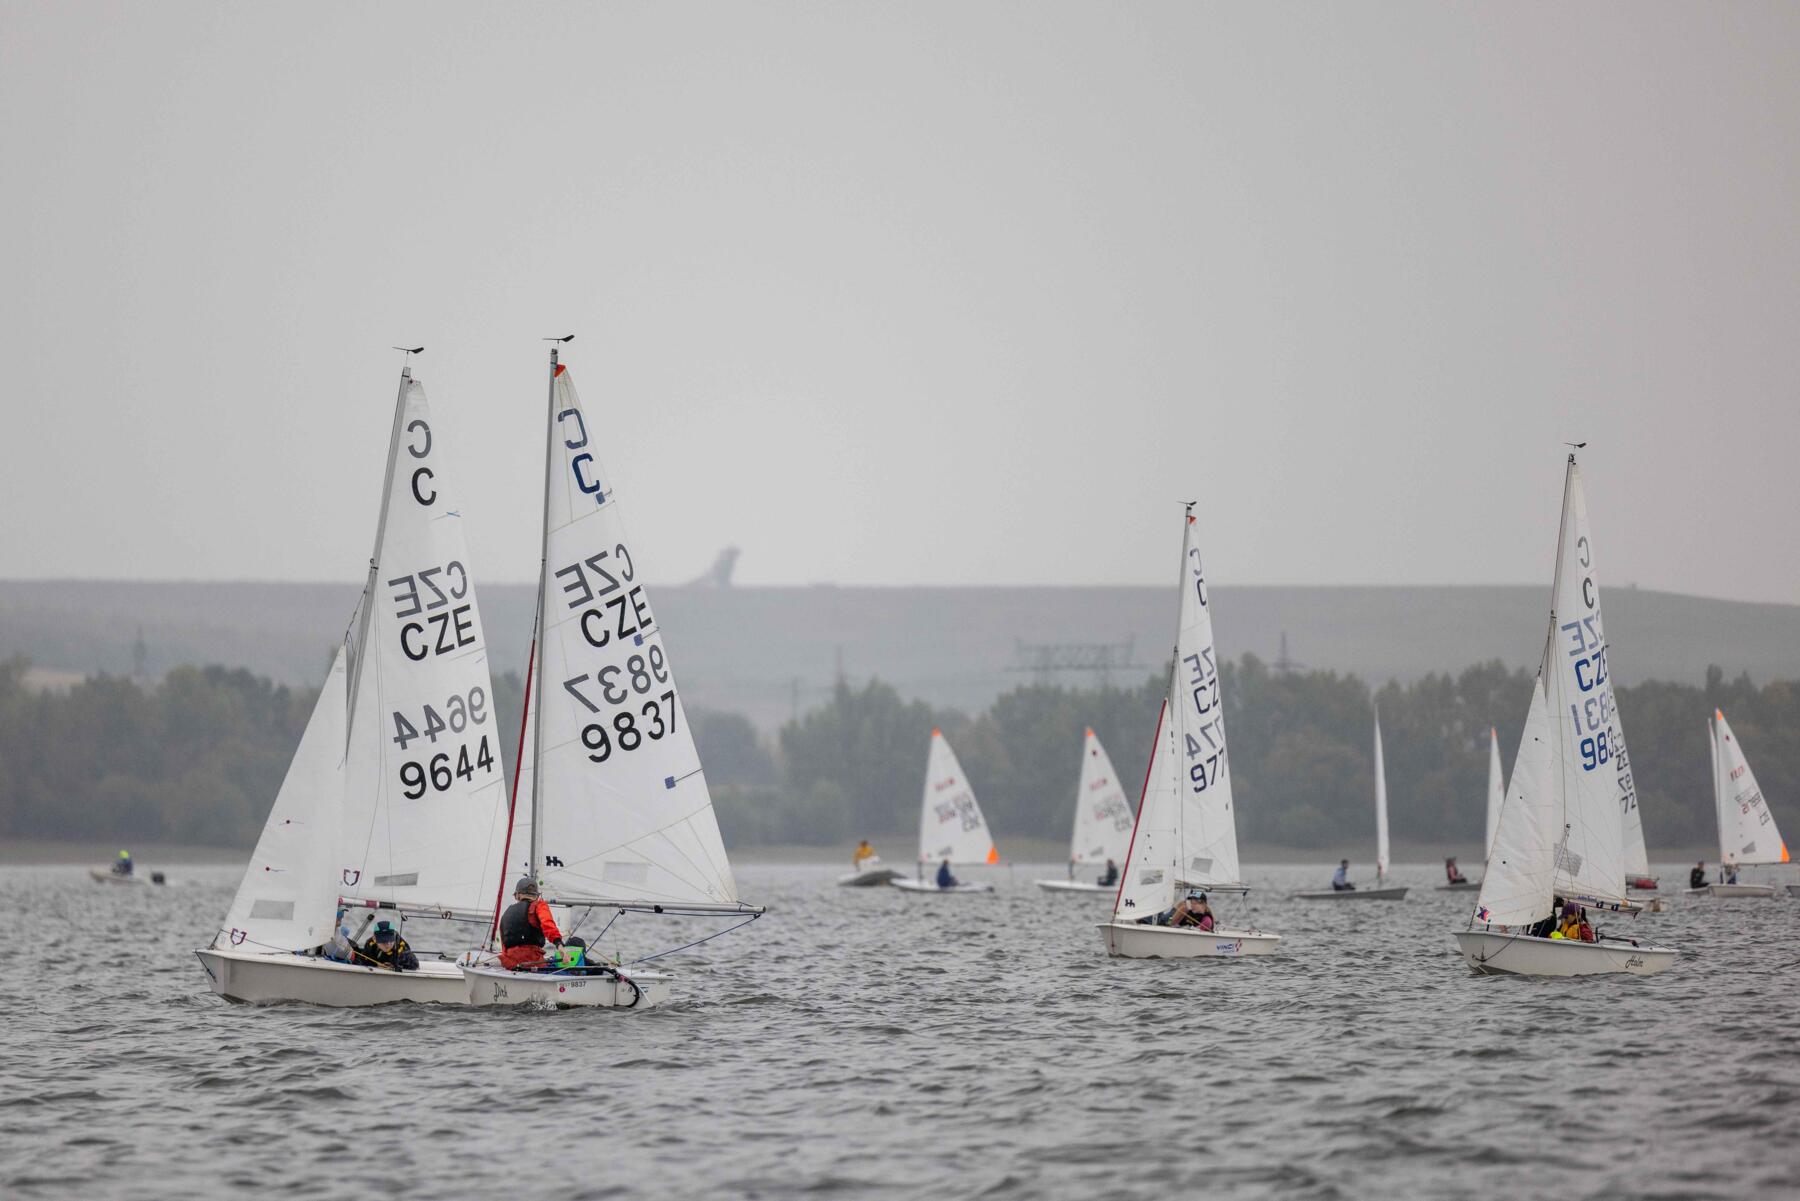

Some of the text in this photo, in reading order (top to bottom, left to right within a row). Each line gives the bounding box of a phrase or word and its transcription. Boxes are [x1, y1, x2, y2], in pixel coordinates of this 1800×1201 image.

[411, 467, 437, 506] C
[571, 453, 600, 494] C
[1197, 578, 1207, 606] C
[1582, 577, 1594, 609] C
[400, 604, 476, 661] CZE
[580, 585, 653, 648] CZE
[1193, 677, 1220, 714] CZ
[581, 690, 676, 763] 9837
[399, 735, 495, 800] 9644
[1580, 726, 1614, 771] 983
[1615, 750, 1629, 772] ZE
[1190, 747, 1226, 793] 977
[1620, 792, 1637, 815] 72
